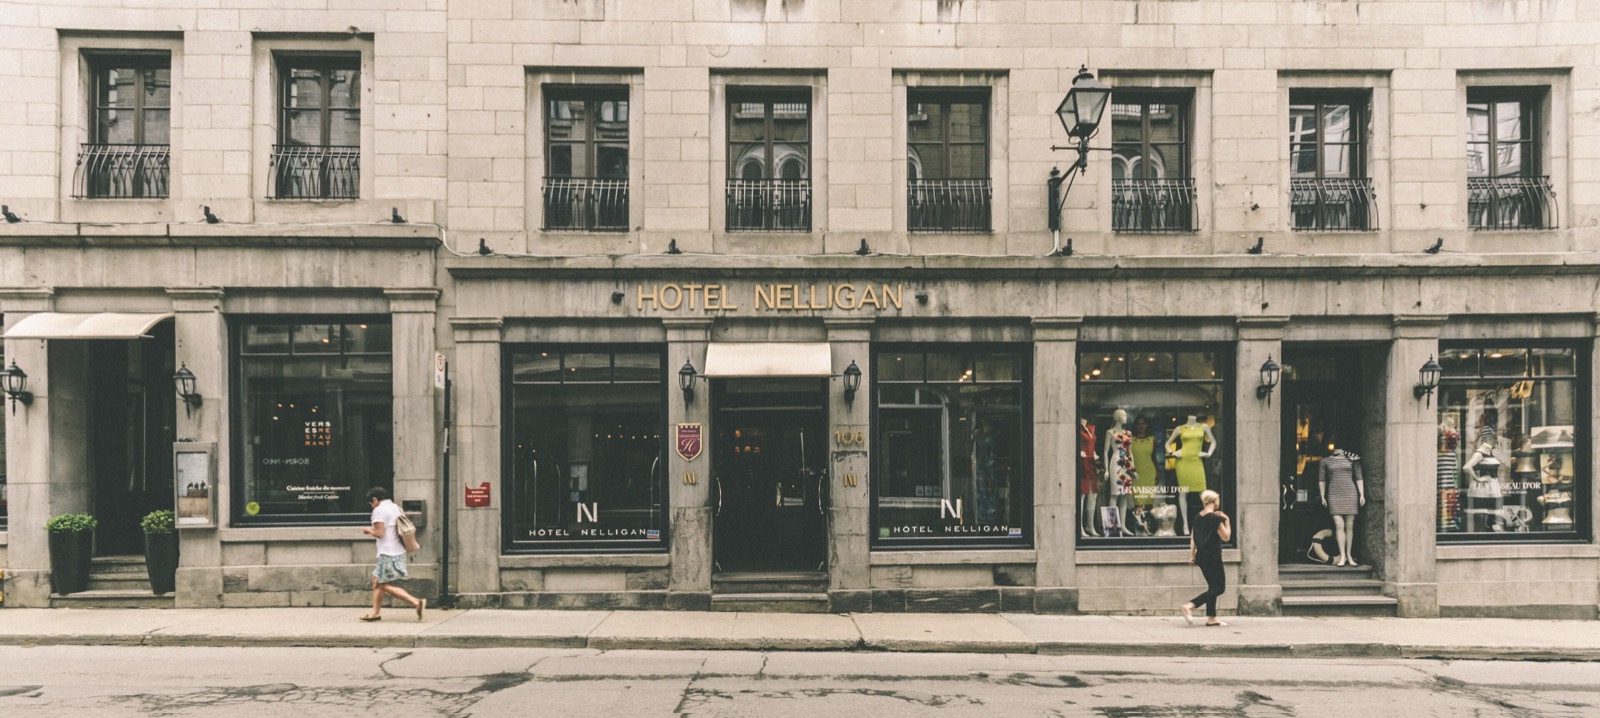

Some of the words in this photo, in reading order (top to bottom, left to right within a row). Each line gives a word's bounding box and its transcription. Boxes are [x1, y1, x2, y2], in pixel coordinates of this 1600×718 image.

[637, 284, 737, 310] HOTEL
[754, 284, 902, 310] NELLIGAN
[835, 430, 864, 444] 106
[683, 471, 696, 485] N
[844, 473, 857, 487] N
[1133, 486, 1169, 494] VAISSEAU
[1171, 486, 1189, 494] D'OR
[577, 502, 597, 522] N
[941, 499, 960, 519] N
[581, 528, 646, 536] NELLIGAN
[945, 525, 1008, 533] NELLIGAN
